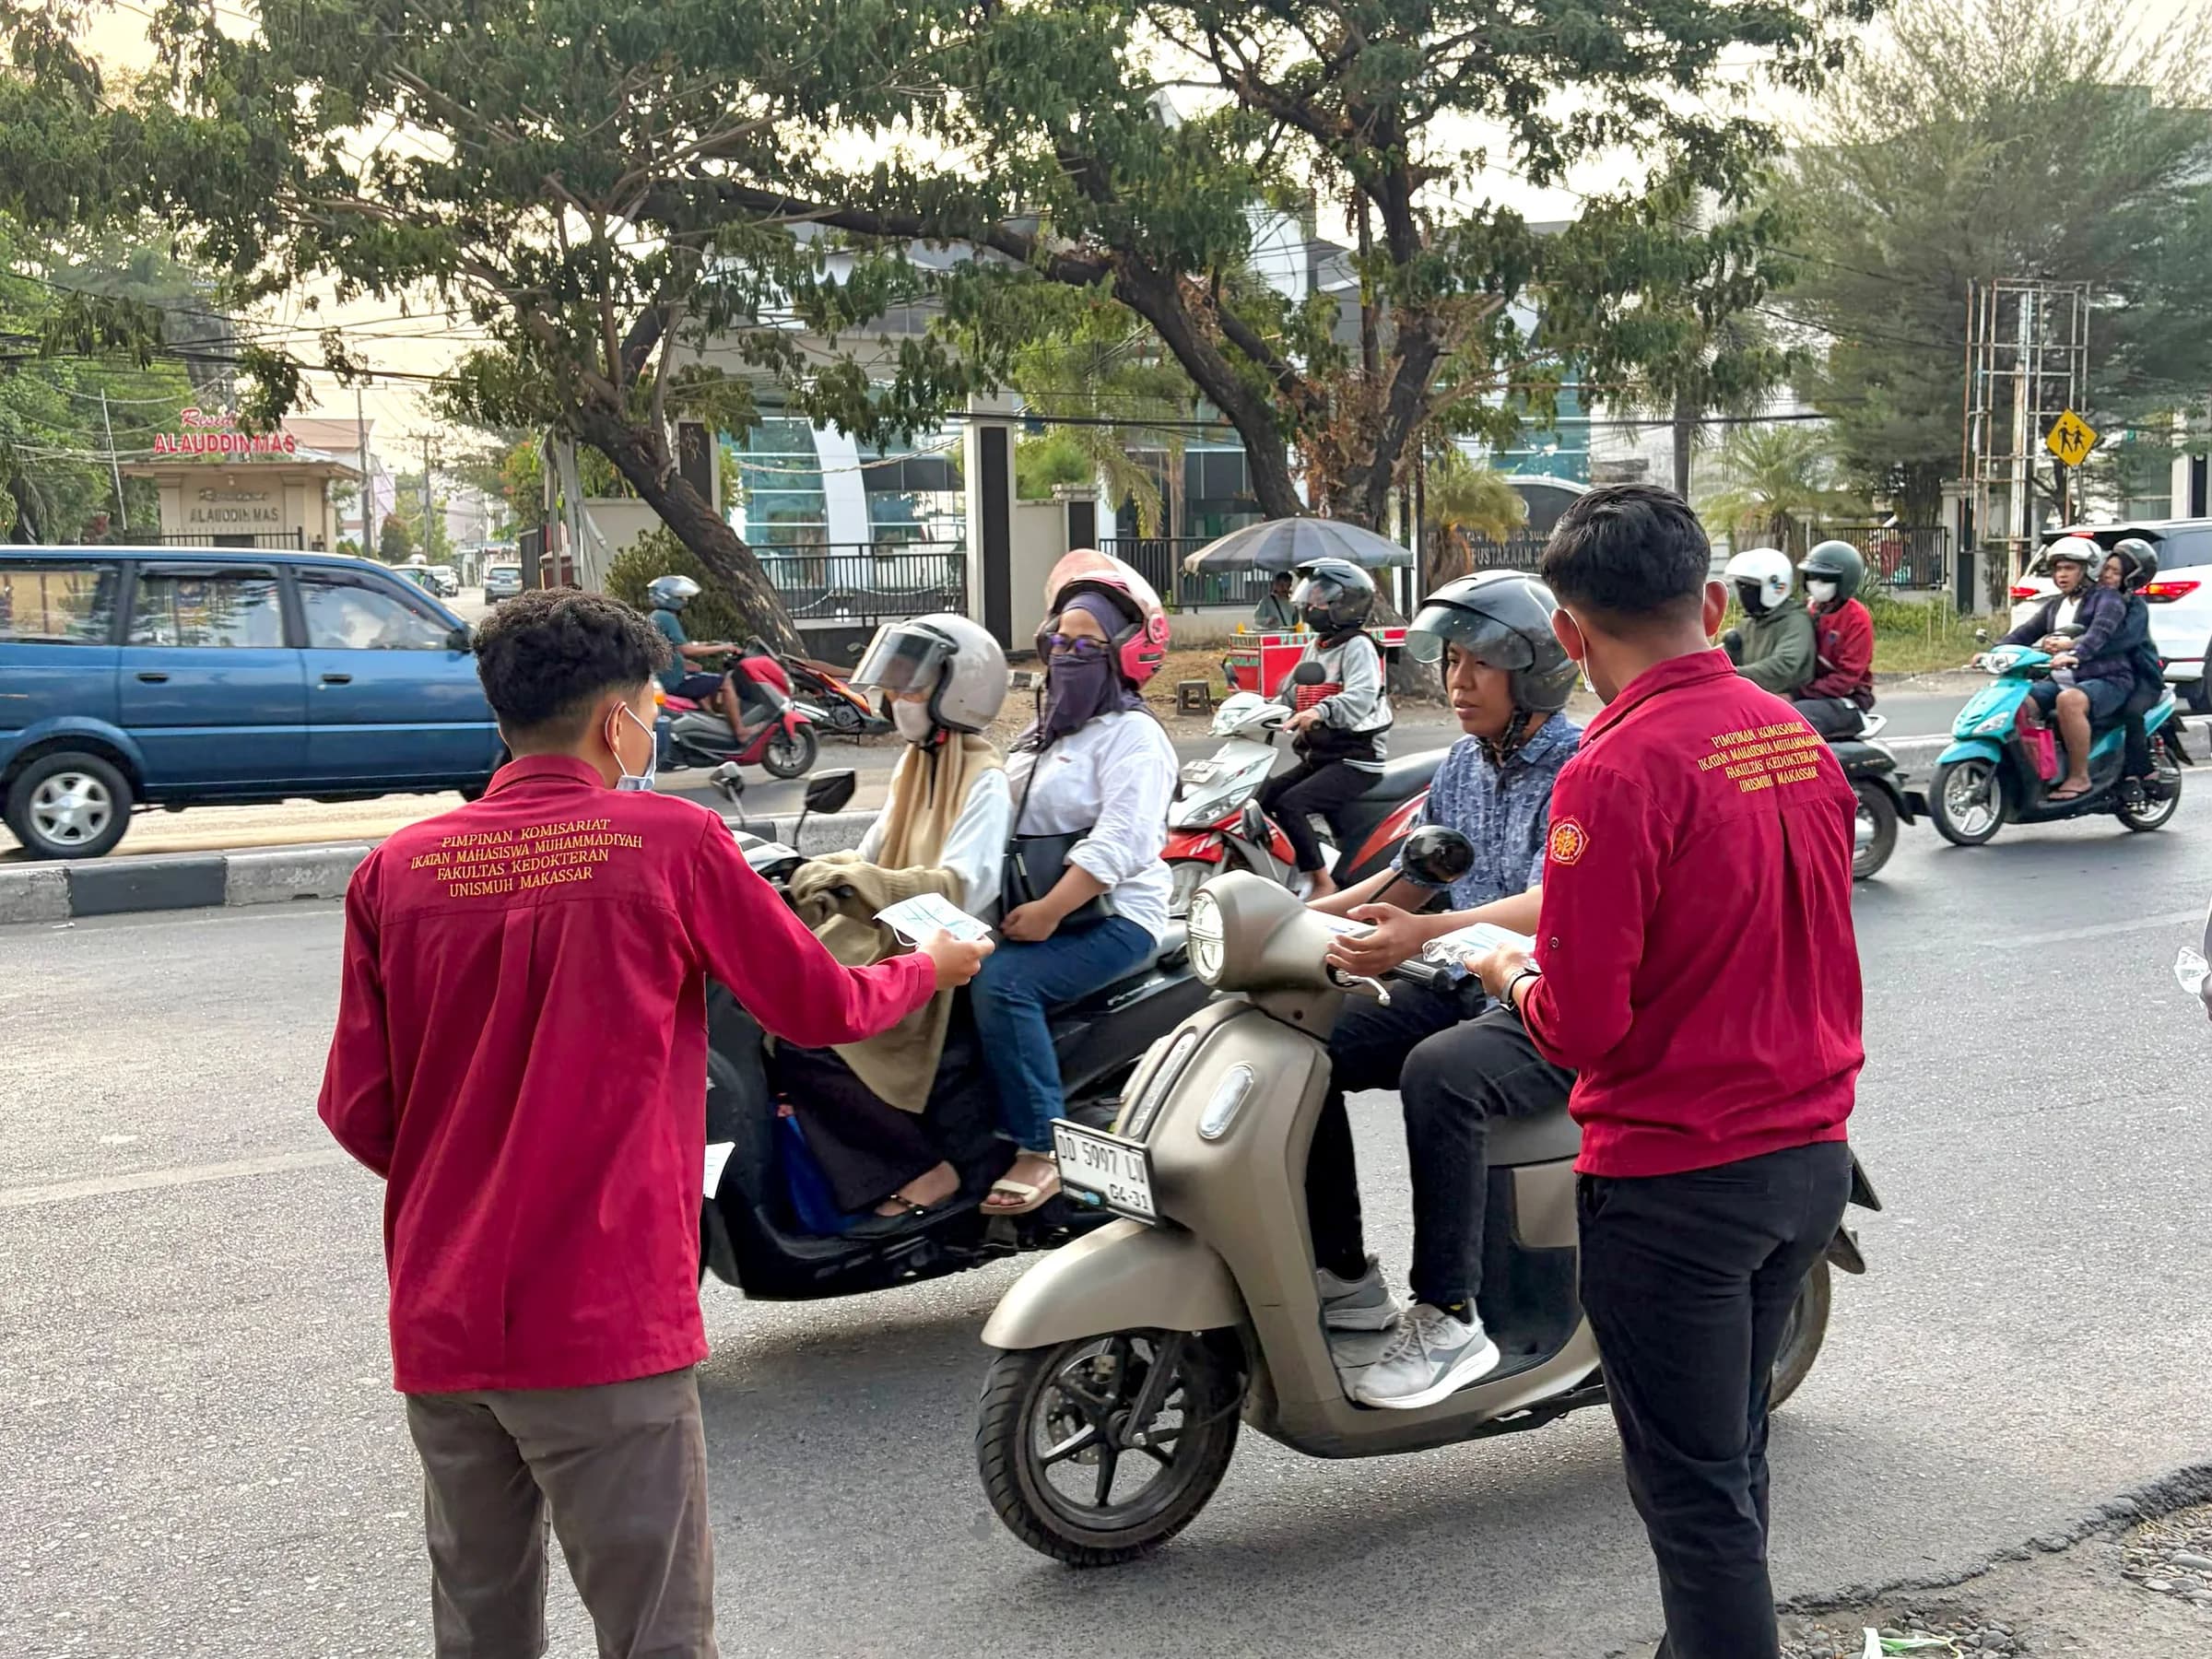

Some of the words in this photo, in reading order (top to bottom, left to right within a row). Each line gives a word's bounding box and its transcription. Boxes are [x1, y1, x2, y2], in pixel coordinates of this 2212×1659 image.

[154, 433, 251, 453] ALAUDDIN
[253, 434, 296, 454] MAS
[253, 508, 279, 523] MAS
[1711, 729, 1756, 748] PIMPINAN
[1698, 751, 1730, 771] IKATAN
[1730, 742, 1774, 760] MAHASISWA
[1725, 759, 1764, 779] FAKULTAS
[1766, 748, 1821, 770] KEDOKTERAN
[1739, 774, 1774, 793] UNISMUH
[1776, 766, 1818, 785] MAKASSAR
[441, 830, 513, 848] PIMPINAN
[520, 818, 611, 840] KOMISARIAT
[410, 852, 451, 870] IKATAN
[456, 843, 530, 864] MAHASISWA
[535, 832, 643, 854] MUHAMMADIYAH
[436, 863, 505, 881] FAKULTAS
[512, 849, 609, 873] KEDOKTERAN
[450, 878, 513, 898] UNISMUH
[519, 866, 593, 889] MAKASSAR
[1081, 1141, 1118, 1176] 5997
